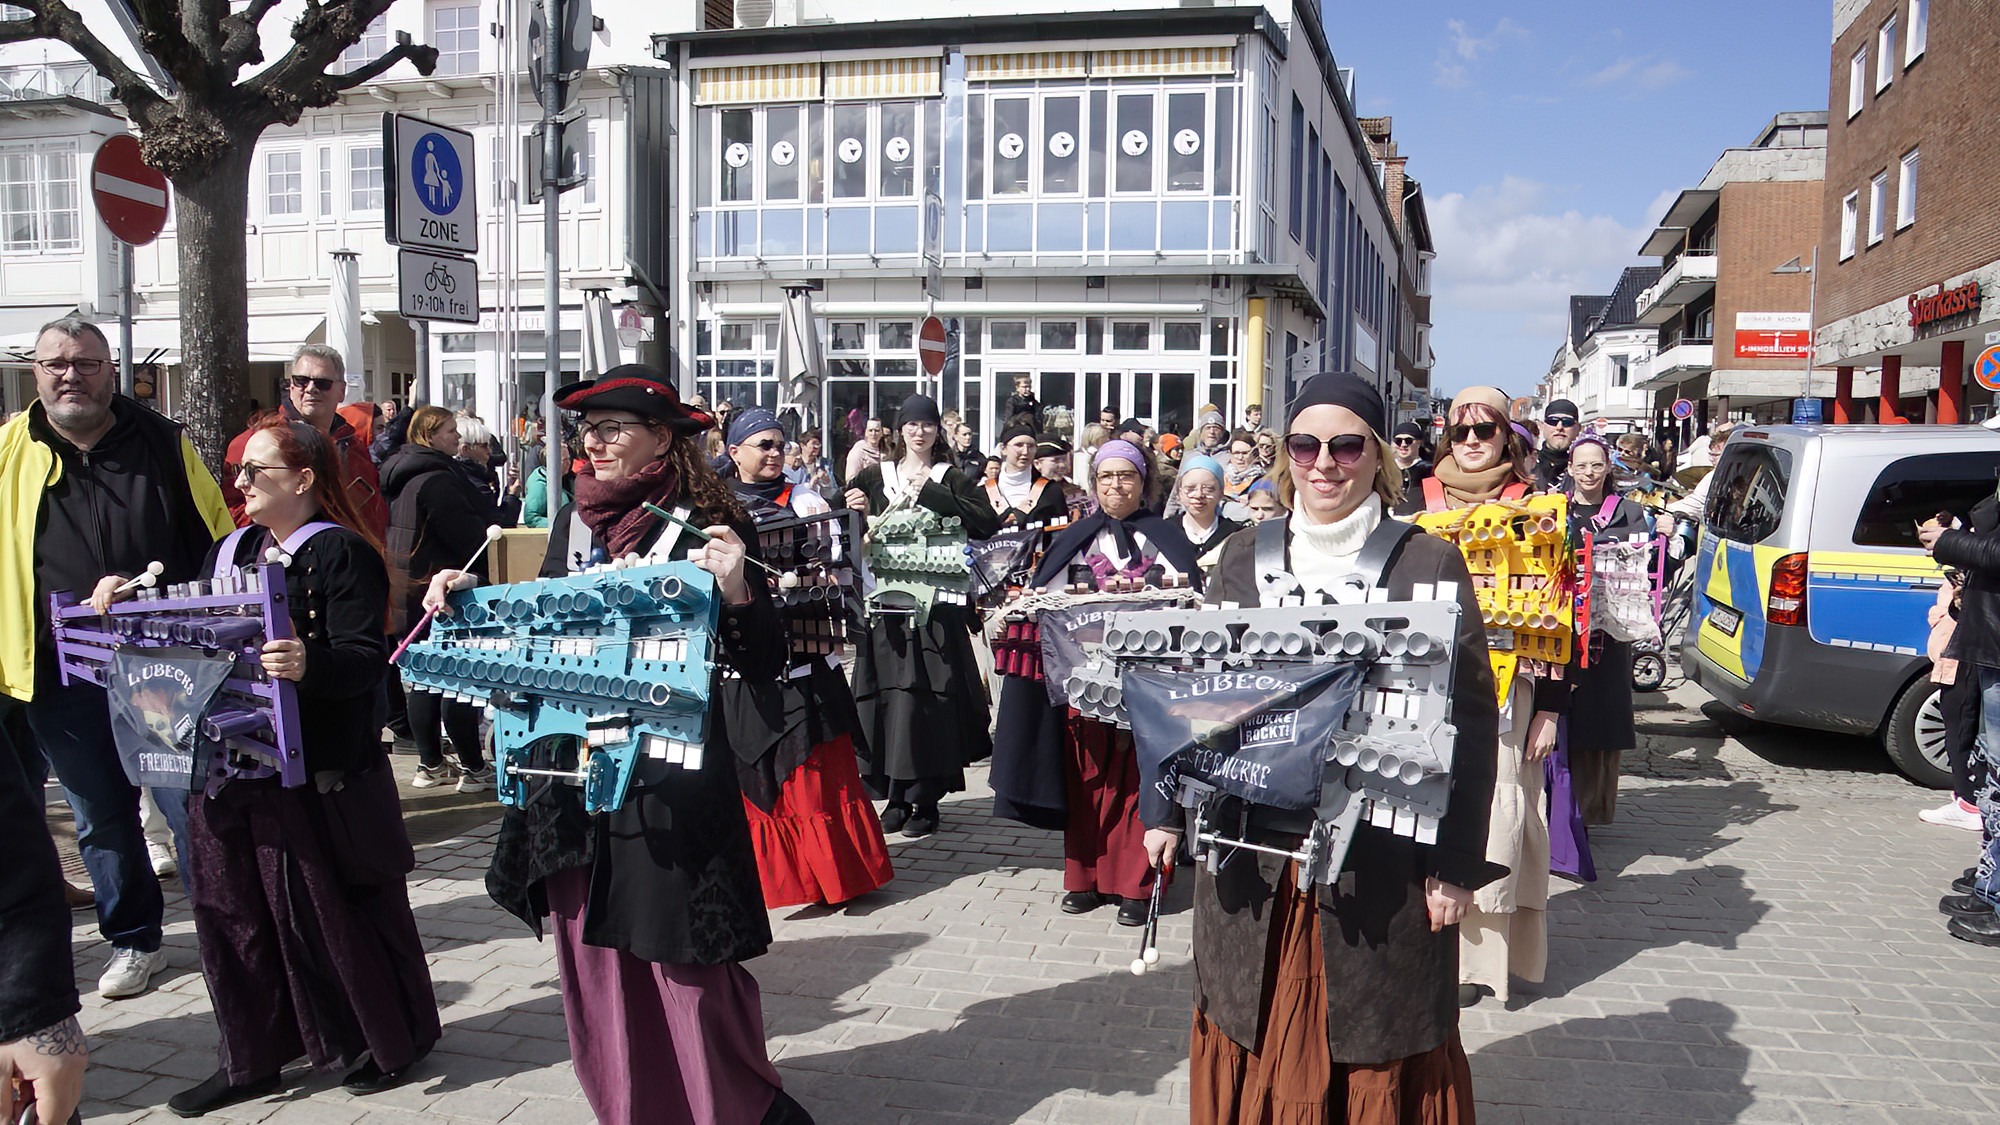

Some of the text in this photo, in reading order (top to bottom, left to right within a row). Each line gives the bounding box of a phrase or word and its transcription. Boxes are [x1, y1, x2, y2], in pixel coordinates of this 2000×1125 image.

[420, 218, 459, 242] ZONE
[412, 294, 469, 315] 19-10h frei
[1908, 282, 1981, 327] Sparkasse
[1245, 724, 1290, 743] ROCKT!
